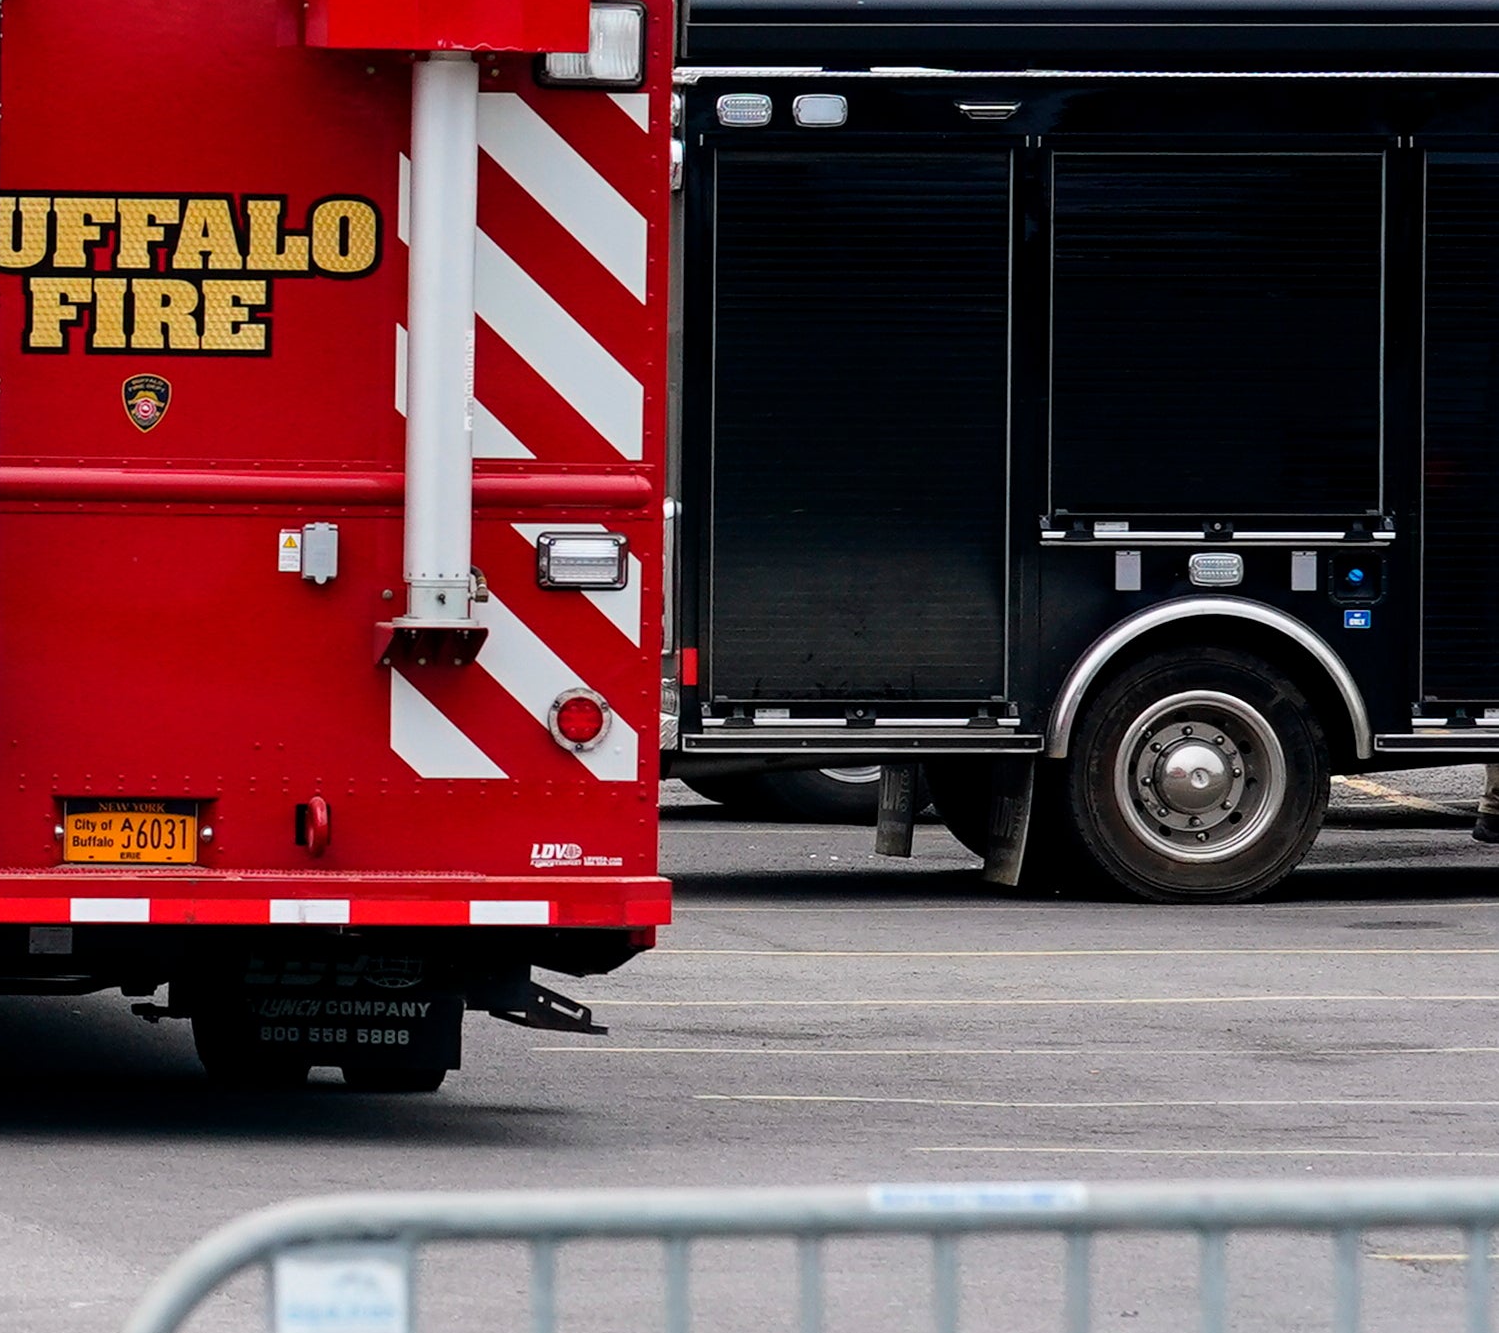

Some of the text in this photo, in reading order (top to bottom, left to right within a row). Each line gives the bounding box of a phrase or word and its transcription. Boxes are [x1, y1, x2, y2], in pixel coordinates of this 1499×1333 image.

[29, 277, 267, 350] FIRE
[98, 802, 166, 813] NEW YORK
[74, 819, 113, 832] City of
[72, 835, 114, 847] Buffalo
[136, 818, 186, 850] 6031
[120, 852, 142, 860] ERIE
[530, 843, 567, 859] LDV
[259, 999, 431, 1018] LYNCH COMPANY
[260, 1026, 300, 1042] 800
